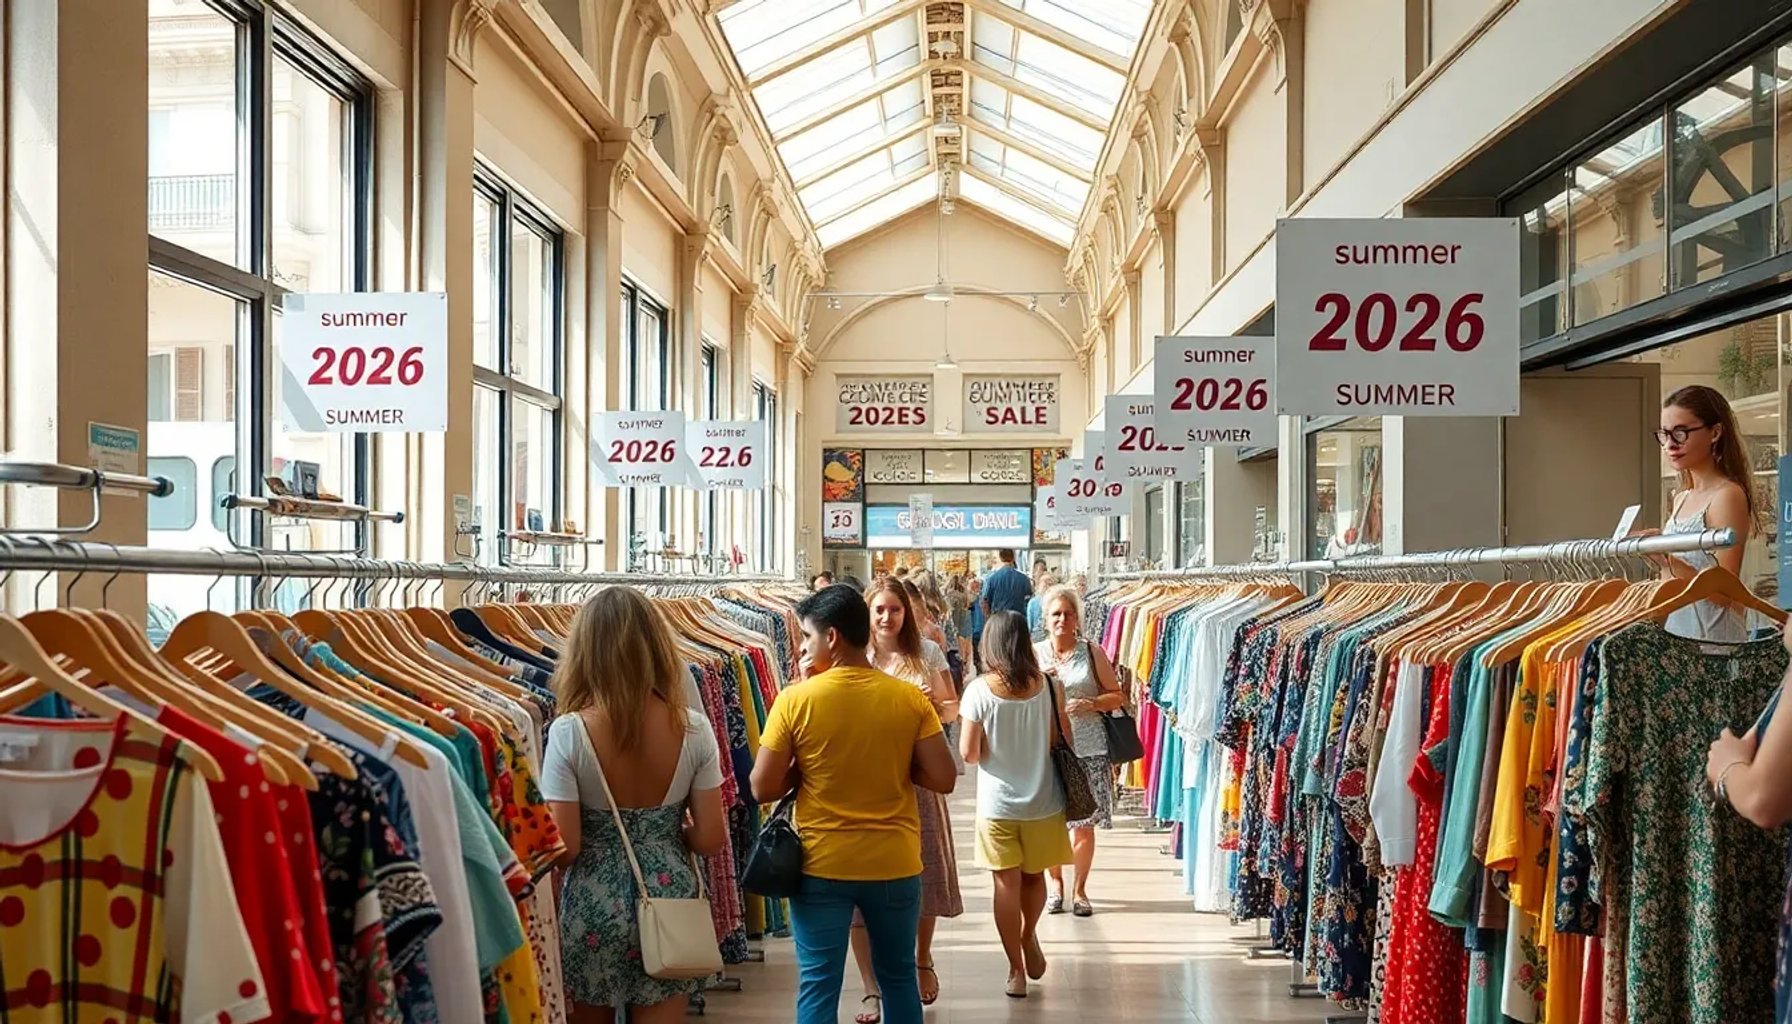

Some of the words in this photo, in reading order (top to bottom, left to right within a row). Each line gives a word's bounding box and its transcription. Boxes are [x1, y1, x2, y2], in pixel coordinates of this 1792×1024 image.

[1335, 243, 1461, 265] summer
[321, 312, 408, 327] summer
[1308, 292, 1485, 352] 2026
[308, 346, 424, 387] 2026
[1170, 377, 1268, 411] 2026
[1335, 383, 1455, 407] SUMMER
[325, 408, 404, 425] SUMMER
[984, 406, 1048, 425] SALE
[607, 439, 676, 463] 2026
